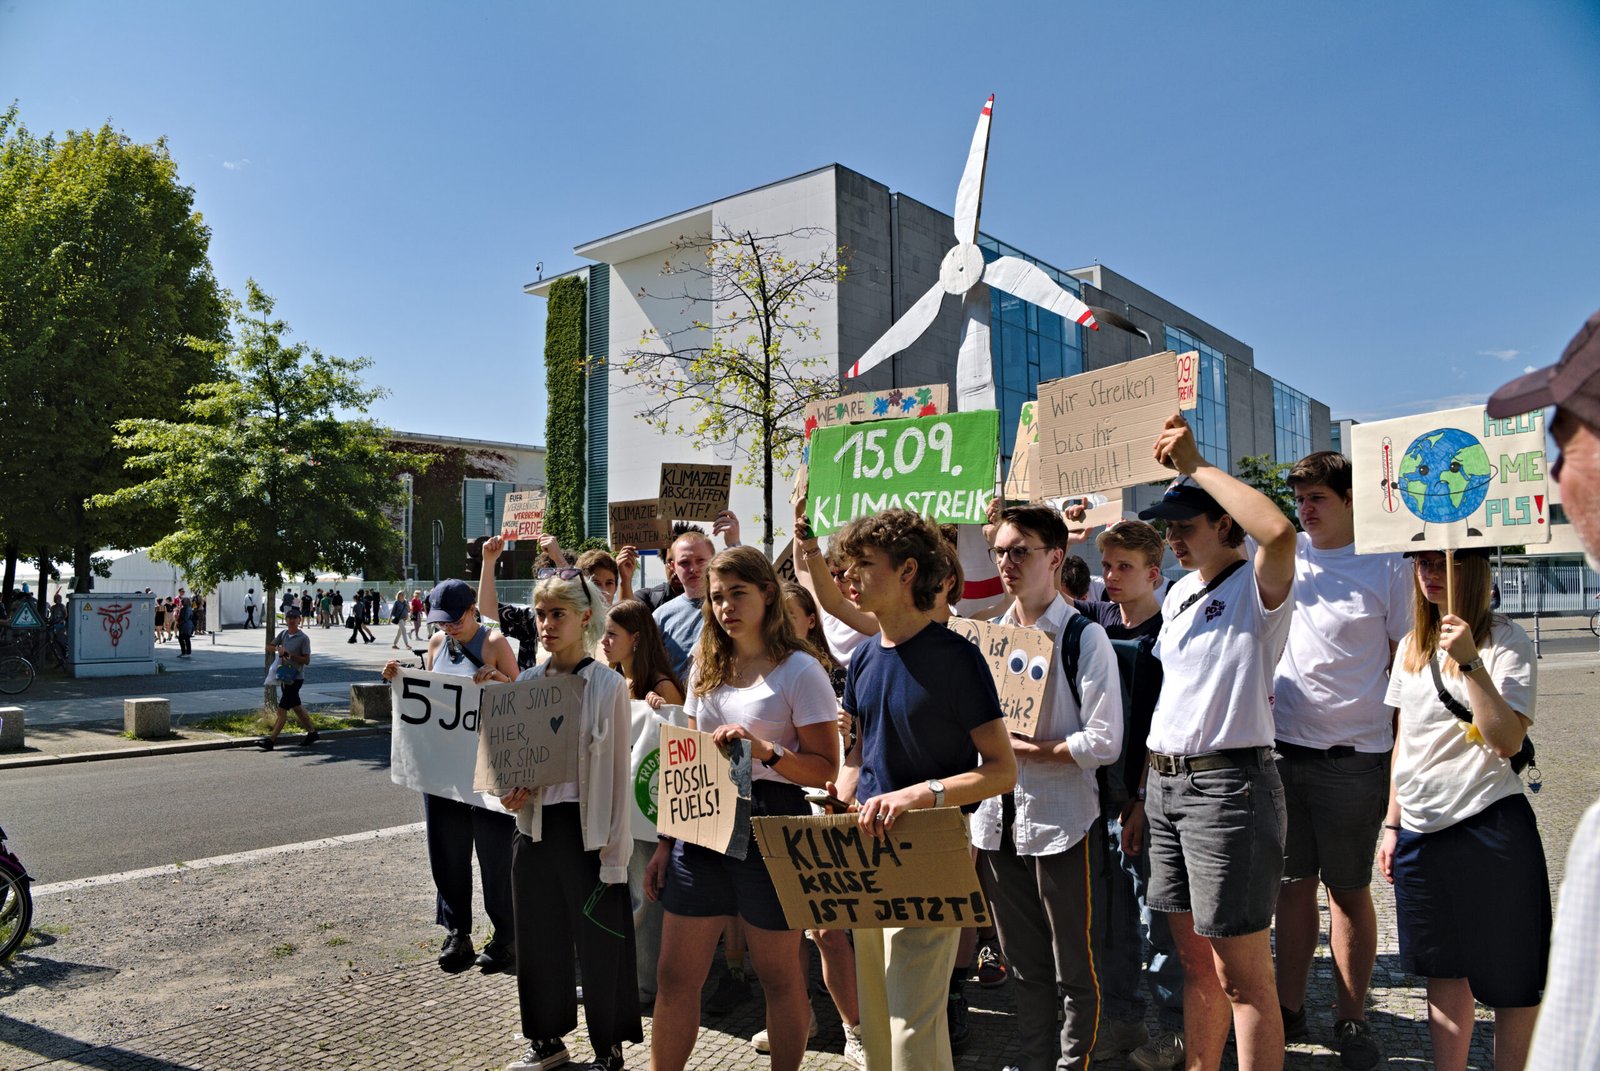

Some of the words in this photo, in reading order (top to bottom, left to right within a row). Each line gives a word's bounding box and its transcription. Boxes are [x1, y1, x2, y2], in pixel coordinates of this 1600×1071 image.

[1051, 389, 1078, 418] Wir
[1088, 375, 1155, 407] Streiken
[817, 404, 837, 422] WE
[843, 401, 865, 416] ARE
[833, 422, 963, 480] 15.09.
[1053, 429, 1084, 455] bis
[1092, 423, 1117, 448] ihr
[662, 468, 731, 487] KLIMAZIELE
[1056, 443, 1132, 495] handelt!
[1500, 450, 1544, 483] ME
[509, 494, 523, 503] EUER
[661, 485, 729, 501] ABSCHAFFEN
[674, 501, 711, 518] WTF!
[1485, 494, 1545, 527] PLS!
[519, 521, 542, 536] ERDE
[612, 530, 659, 545] EINHALTEN
[989, 636, 1009, 657] ist
[401, 677, 432, 725] 5
[491, 690, 516, 718] WIR
[526, 686, 562, 710] SIND
[490, 722, 530, 745] HIER,
[487, 750, 511, 769] WIR
[517, 745, 550, 768] SIND
[668, 737, 697, 766] END
[486, 769, 535, 786] LAUT!!!
[664, 763, 715, 795] FOSSIL
[670, 788, 721, 825] FUELS!
[782, 825, 912, 870] KLIMA-
[798, 870, 883, 894] KRISE
[808, 898, 859, 924] IST
[873, 891, 987, 923] JETZT!
